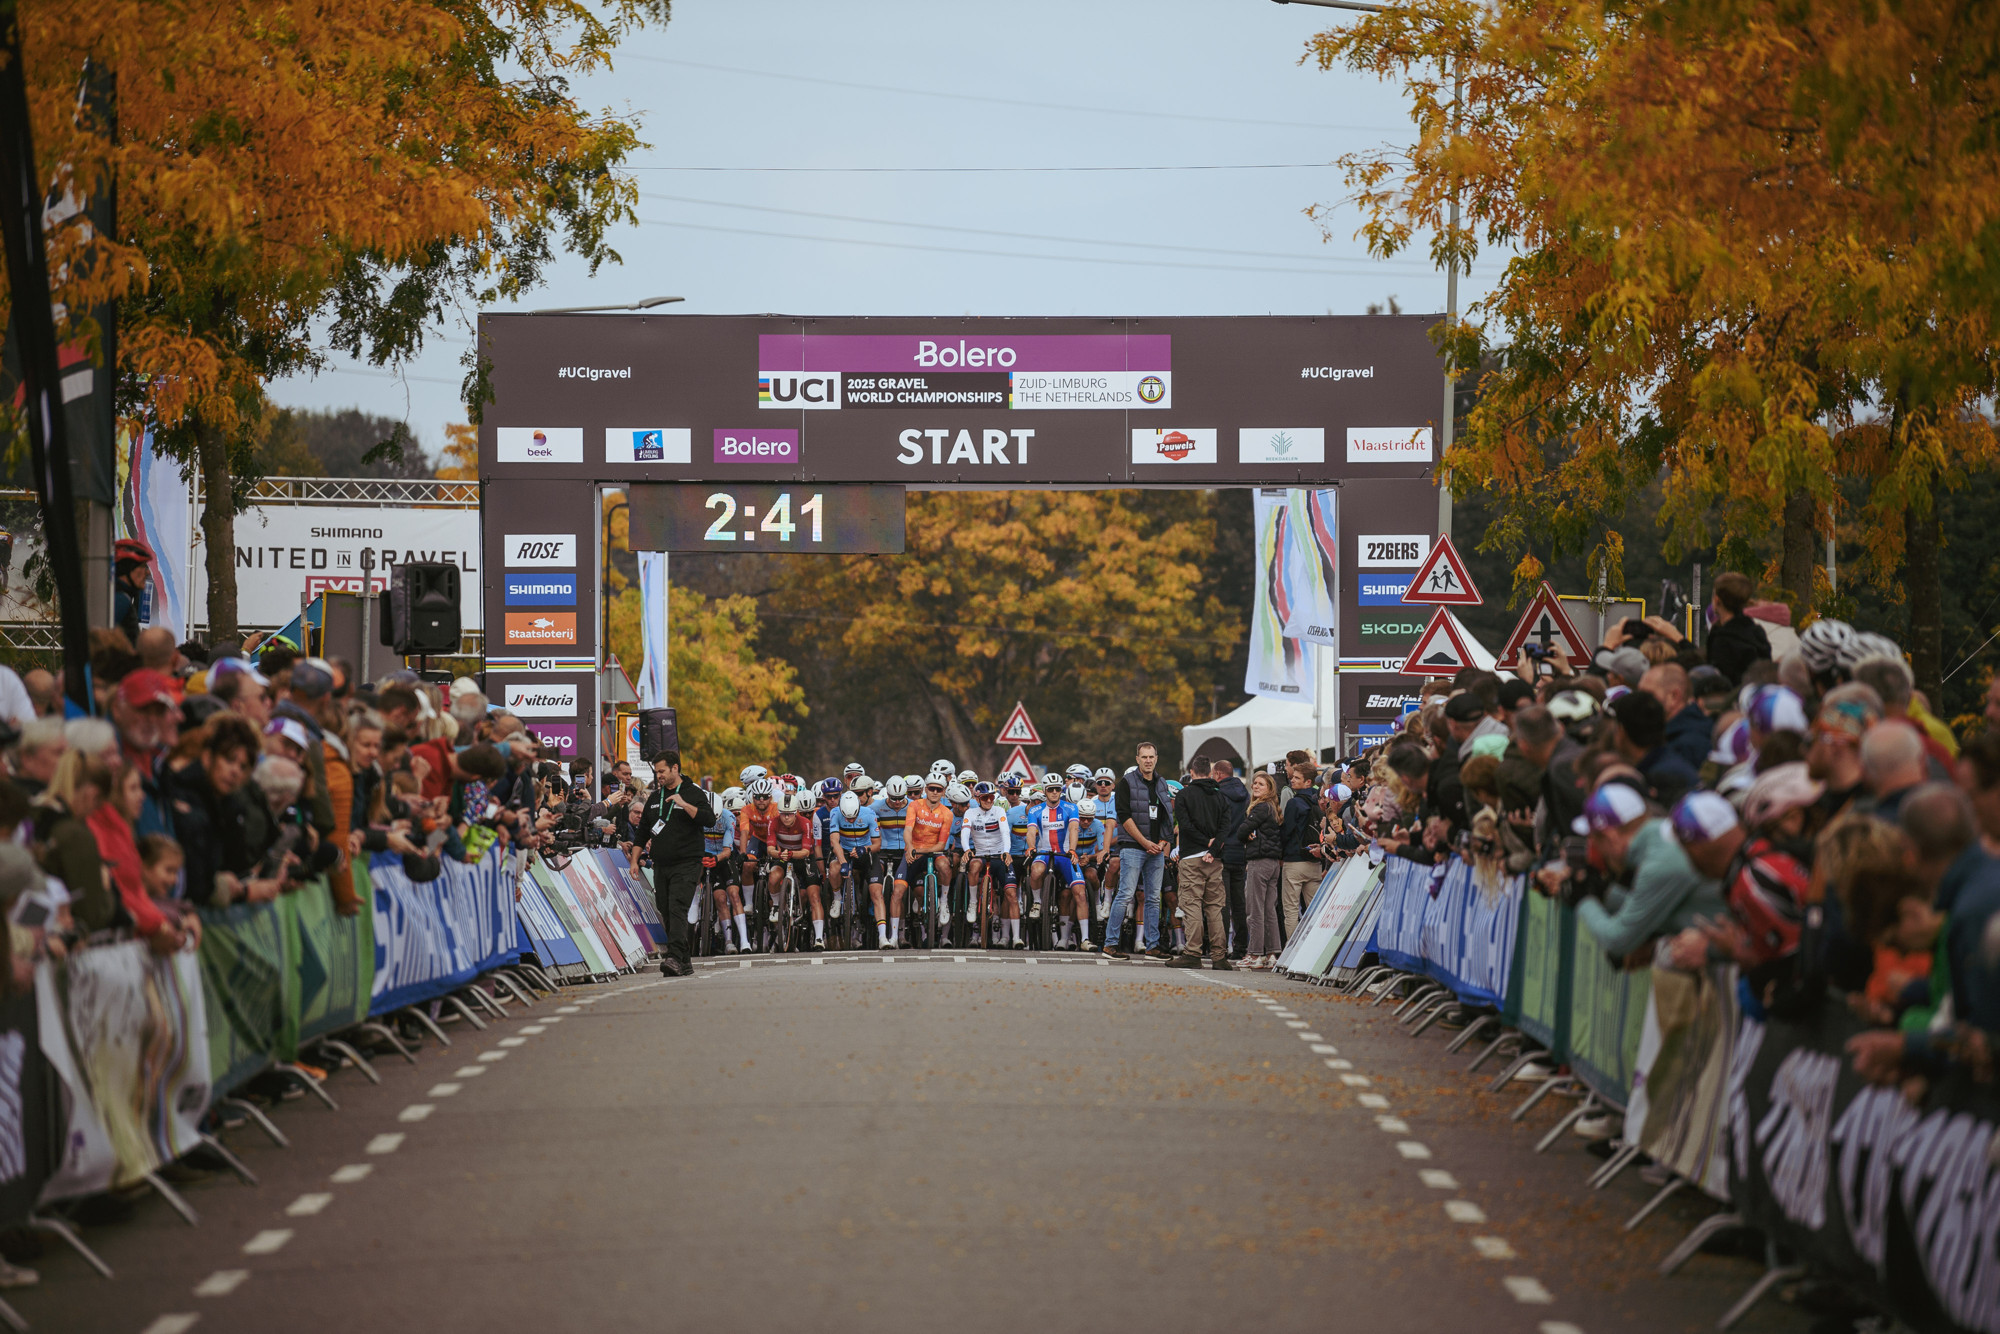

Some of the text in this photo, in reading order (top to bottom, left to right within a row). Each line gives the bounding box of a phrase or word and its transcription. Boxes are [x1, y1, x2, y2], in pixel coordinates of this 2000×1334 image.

[914, 340, 1017, 367] Bolero
[558, 367, 631, 381] #UCIgravel
[1301, 366, 1374, 381] #UCIgravel
[848, 379, 928, 389] 2025 GRAVEL
[1019, 378, 1107, 389] ZUID-LIMBURG
[773, 379, 834, 402] UCI
[848, 392, 1003, 403] WORLD CHAMPIONSHIPS
[1019, 392, 1132, 402] THE NETHERLANDS
[721, 437, 791, 456] Bolero
[897, 429, 1035, 464] START
[1160, 441, 1193, 451] Pauwels
[1353, 439, 1426, 451] Maastricht
[528, 448, 552, 456] beek
[704, 493, 826, 542] 2:41
[311, 528, 383, 539] SHIMANO
[517, 542, 564, 559] ROSE
[1367, 543, 1419, 560] 226ERS
[236, 547, 327, 569] NITED
[337, 554, 350, 565] IN
[509, 585, 572, 594] SHIMANO
[1363, 585, 1407, 595] SHIMA
[509, 629, 574, 639] Staatsloterij
[529, 660, 552, 669] UCI
[1382, 660, 1406, 670] UC
[524, 694, 574, 706] vittoria
[537, 731, 573, 748] lero
